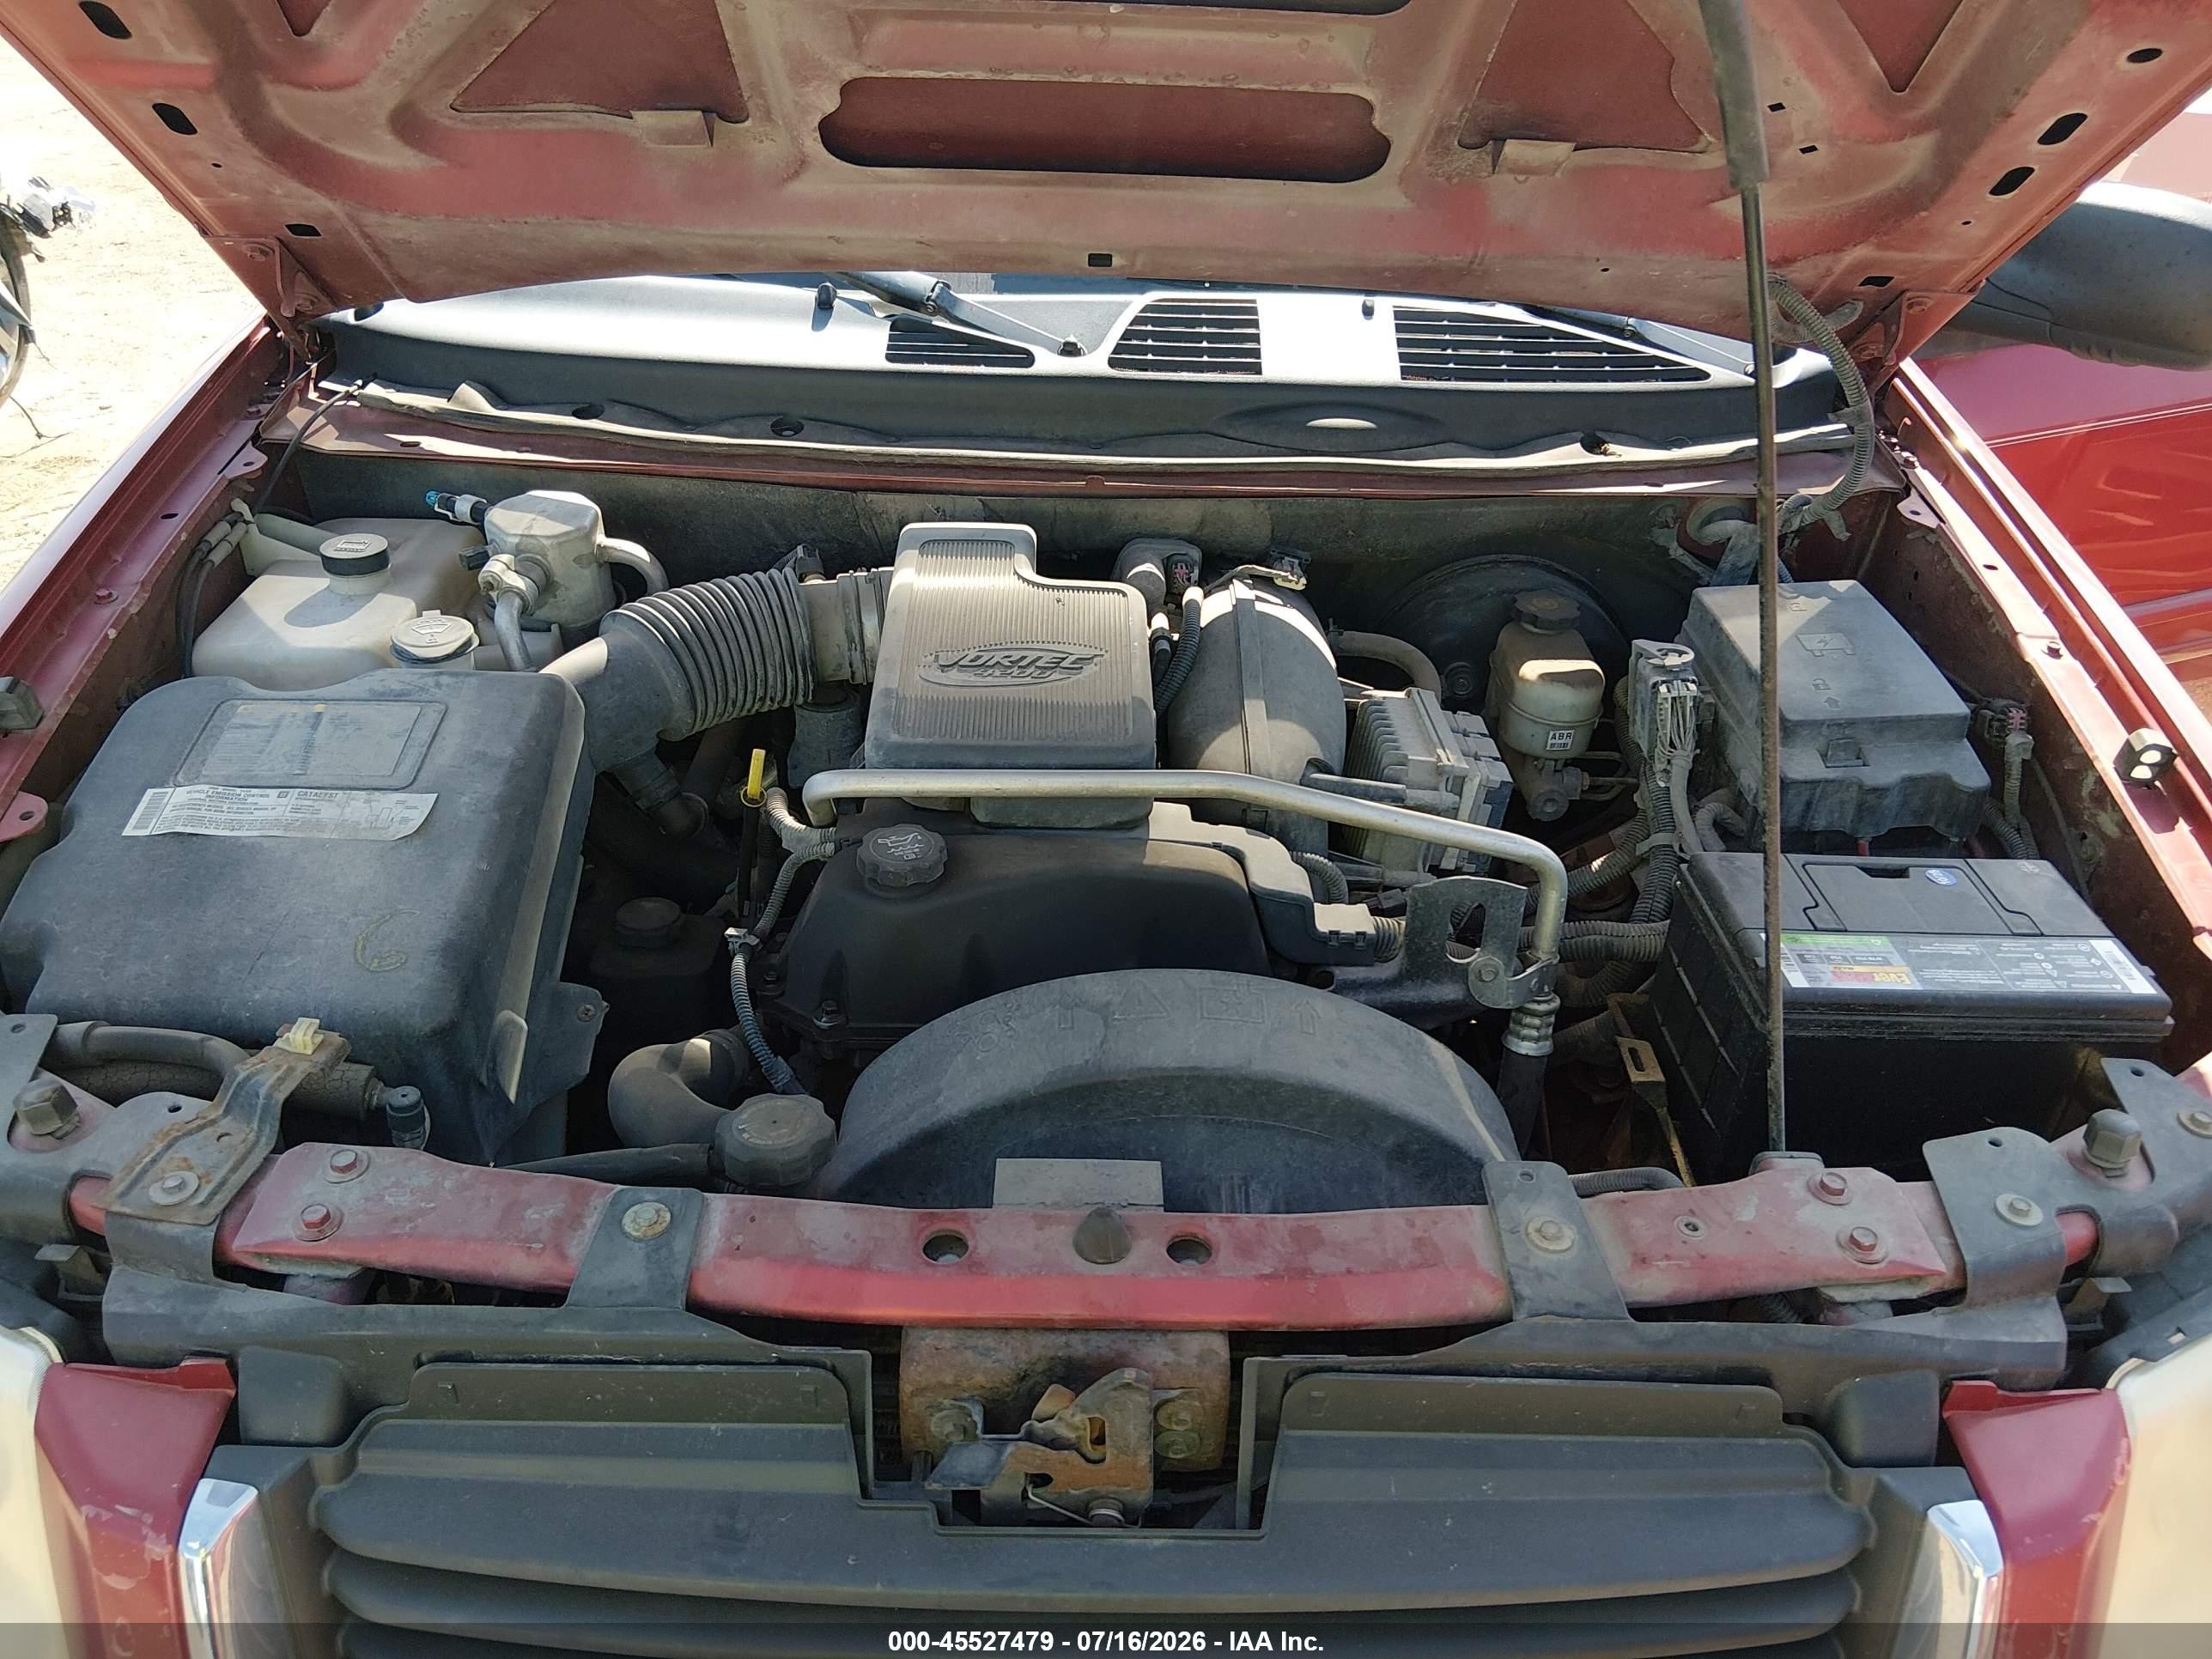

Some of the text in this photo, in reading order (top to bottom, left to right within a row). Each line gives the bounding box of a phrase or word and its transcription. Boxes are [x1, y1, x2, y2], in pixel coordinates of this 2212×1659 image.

[934, 651, 1104, 671] VORTEC
[974, 668, 1058, 679] 4200
[1550, 732, 1572, 740] ABR
[296, 790, 339, 799] CATALYST
